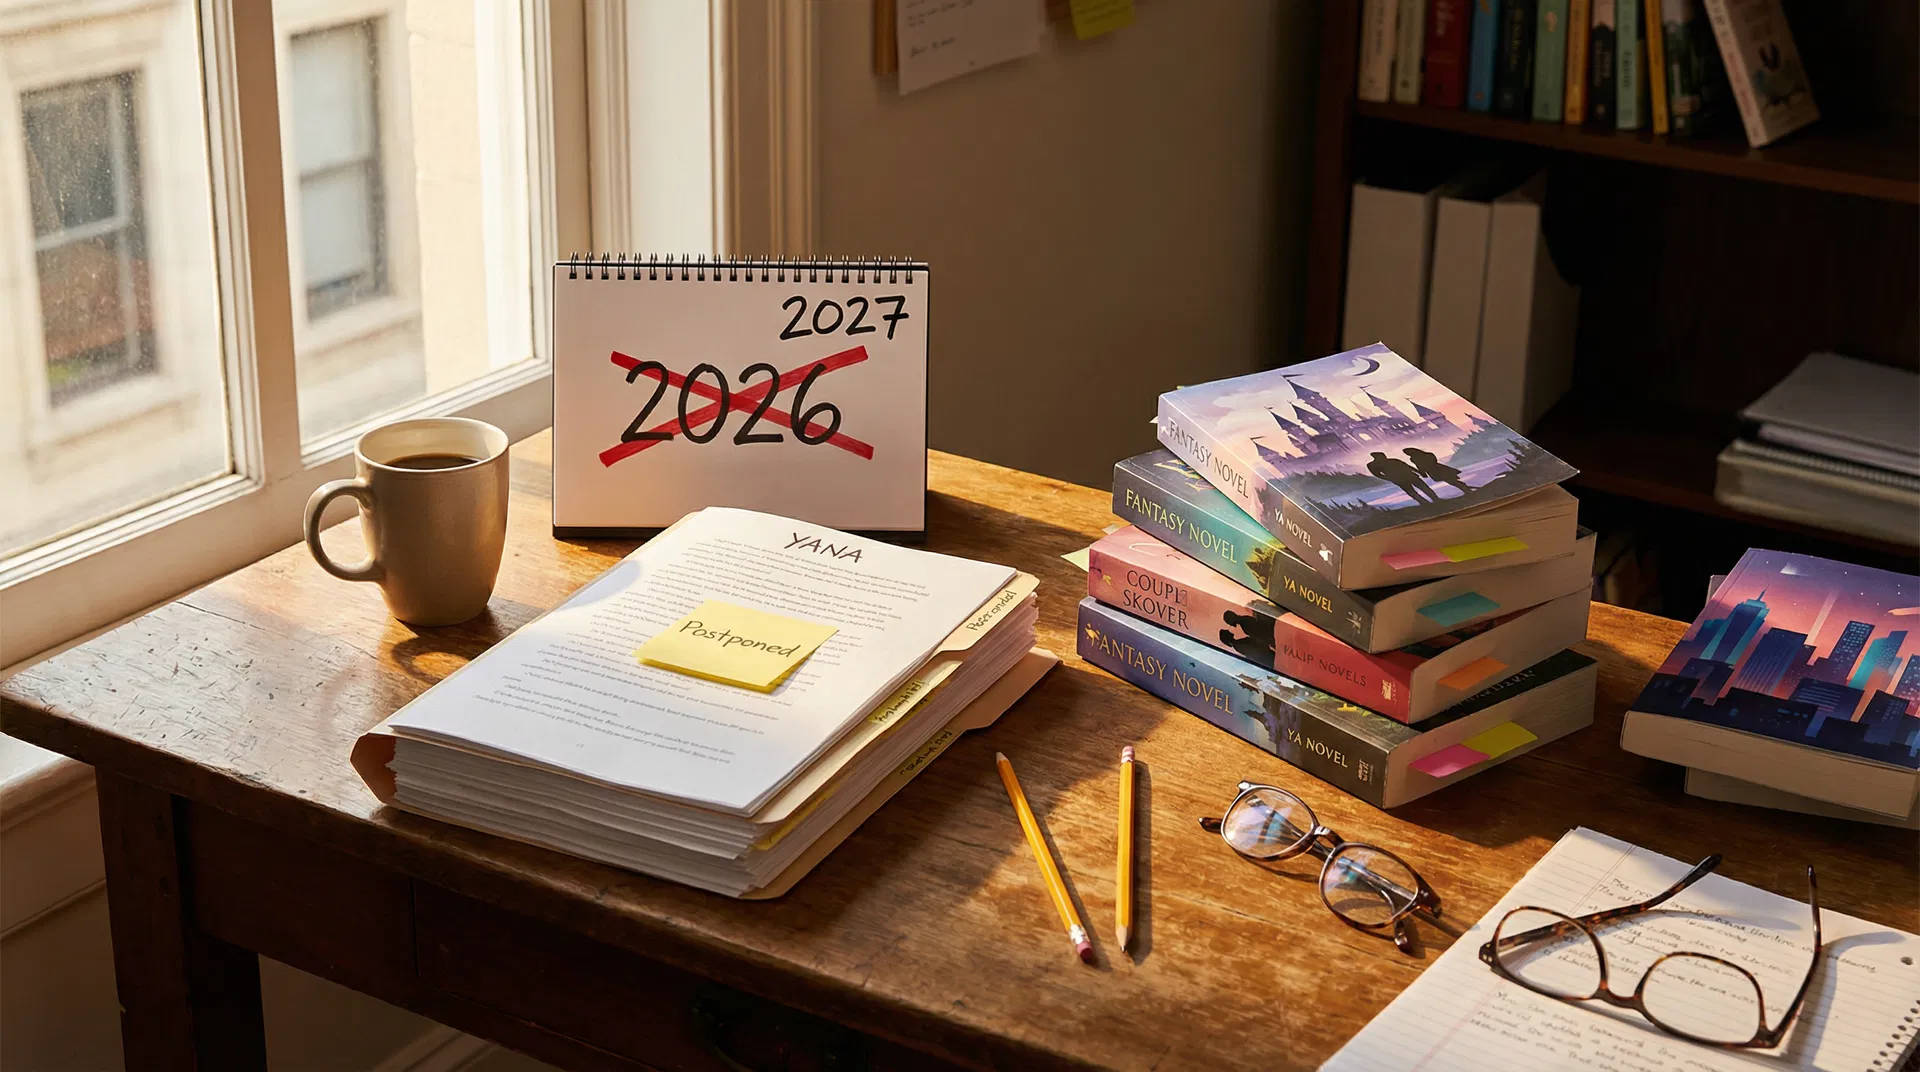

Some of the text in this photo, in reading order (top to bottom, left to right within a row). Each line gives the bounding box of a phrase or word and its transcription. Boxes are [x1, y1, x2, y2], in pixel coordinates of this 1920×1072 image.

[779, 295, 909, 340] 2027
[620, 360, 842, 446] 2026
[1168, 421, 1249, 499] FANTASY NOVEL
[1125, 488, 1237, 564] FANTASY NOVEL
[1274, 508, 1313, 548] YA NOVEL
[784, 532, 864, 563] YANA
[1123, 589, 1189, 630] SKOVER
[1283, 575, 1333, 613] YA NOVEL
[679, 620, 802, 658] Postponed
[1173, 669, 1234, 715] NOVEL
[1319, 659, 1367, 687] NOVELS
[1287, 728, 1348, 768] YA NOVEL
